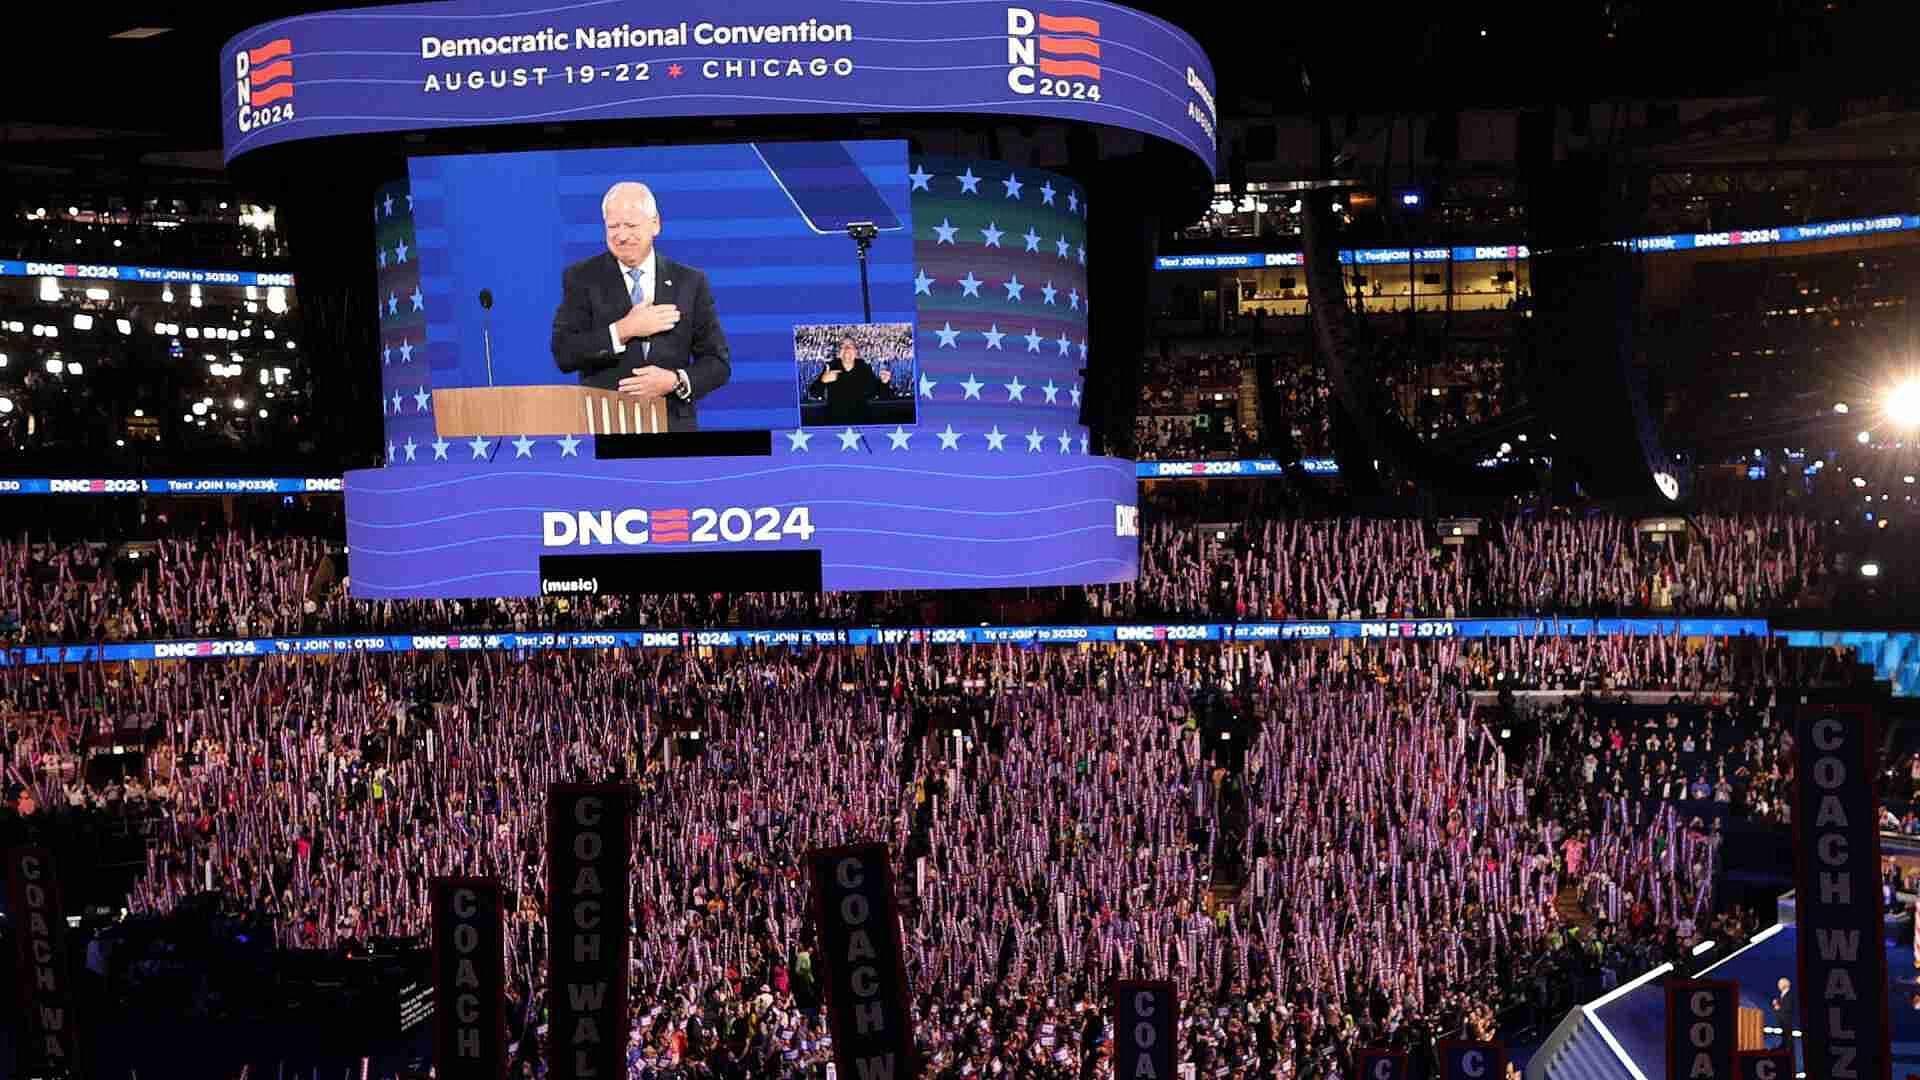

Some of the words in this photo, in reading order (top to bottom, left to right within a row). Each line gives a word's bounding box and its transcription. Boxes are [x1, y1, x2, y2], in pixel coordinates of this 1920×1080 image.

[422, 28, 568, 59] Democratic
[575, 22, 687, 50] National
[694, 18, 852, 43] Convention
[1007, 8, 1034, 94] DNC
[424, 66, 547, 92] AUGUST
[565, 63, 650, 84] 19-22
[703, 57, 853, 78] CHICAGO
[237, 51, 251, 132] DNC
[1040, 78, 1101, 102] 2024
[252, 103, 294, 128] 2024
[1695, 233, 1730, 247] DNC
[1741, 229, 1780, 243] 2024
[1265, 254, 1297, 265] DNC
[1475, 247, 1508, 260] DNC
[26, 262, 65, 278] DNC
[77, 265, 119, 279] 2024
[138, 269, 162, 279] Text
[164, 271, 190, 281] JOIN
[192, 272, 203, 281] to
[1159, 462, 1193, 476] DNC
[1205, 462, 1241, 475] 2024
[50, 479, 91, 493] DNC
[194, 480, 224, 491] JOIN
[543, 508, 649, 547] DNC
[691, 506, 815, 543] 2024
[542, 578, 599, 595] (music)
[539, 635, 566, 646] JON
[643, 632, 679, 647] DNC
[1117, 626, 1155, 641] DNC
[1167, 625, 1207, 640] 2024
[155, 643, 199, 658] DNC
[574, 796, 605, 962] COACH
[836, 856, 884, 1036] COACH
[453, 887, 480, 1058] COACH
